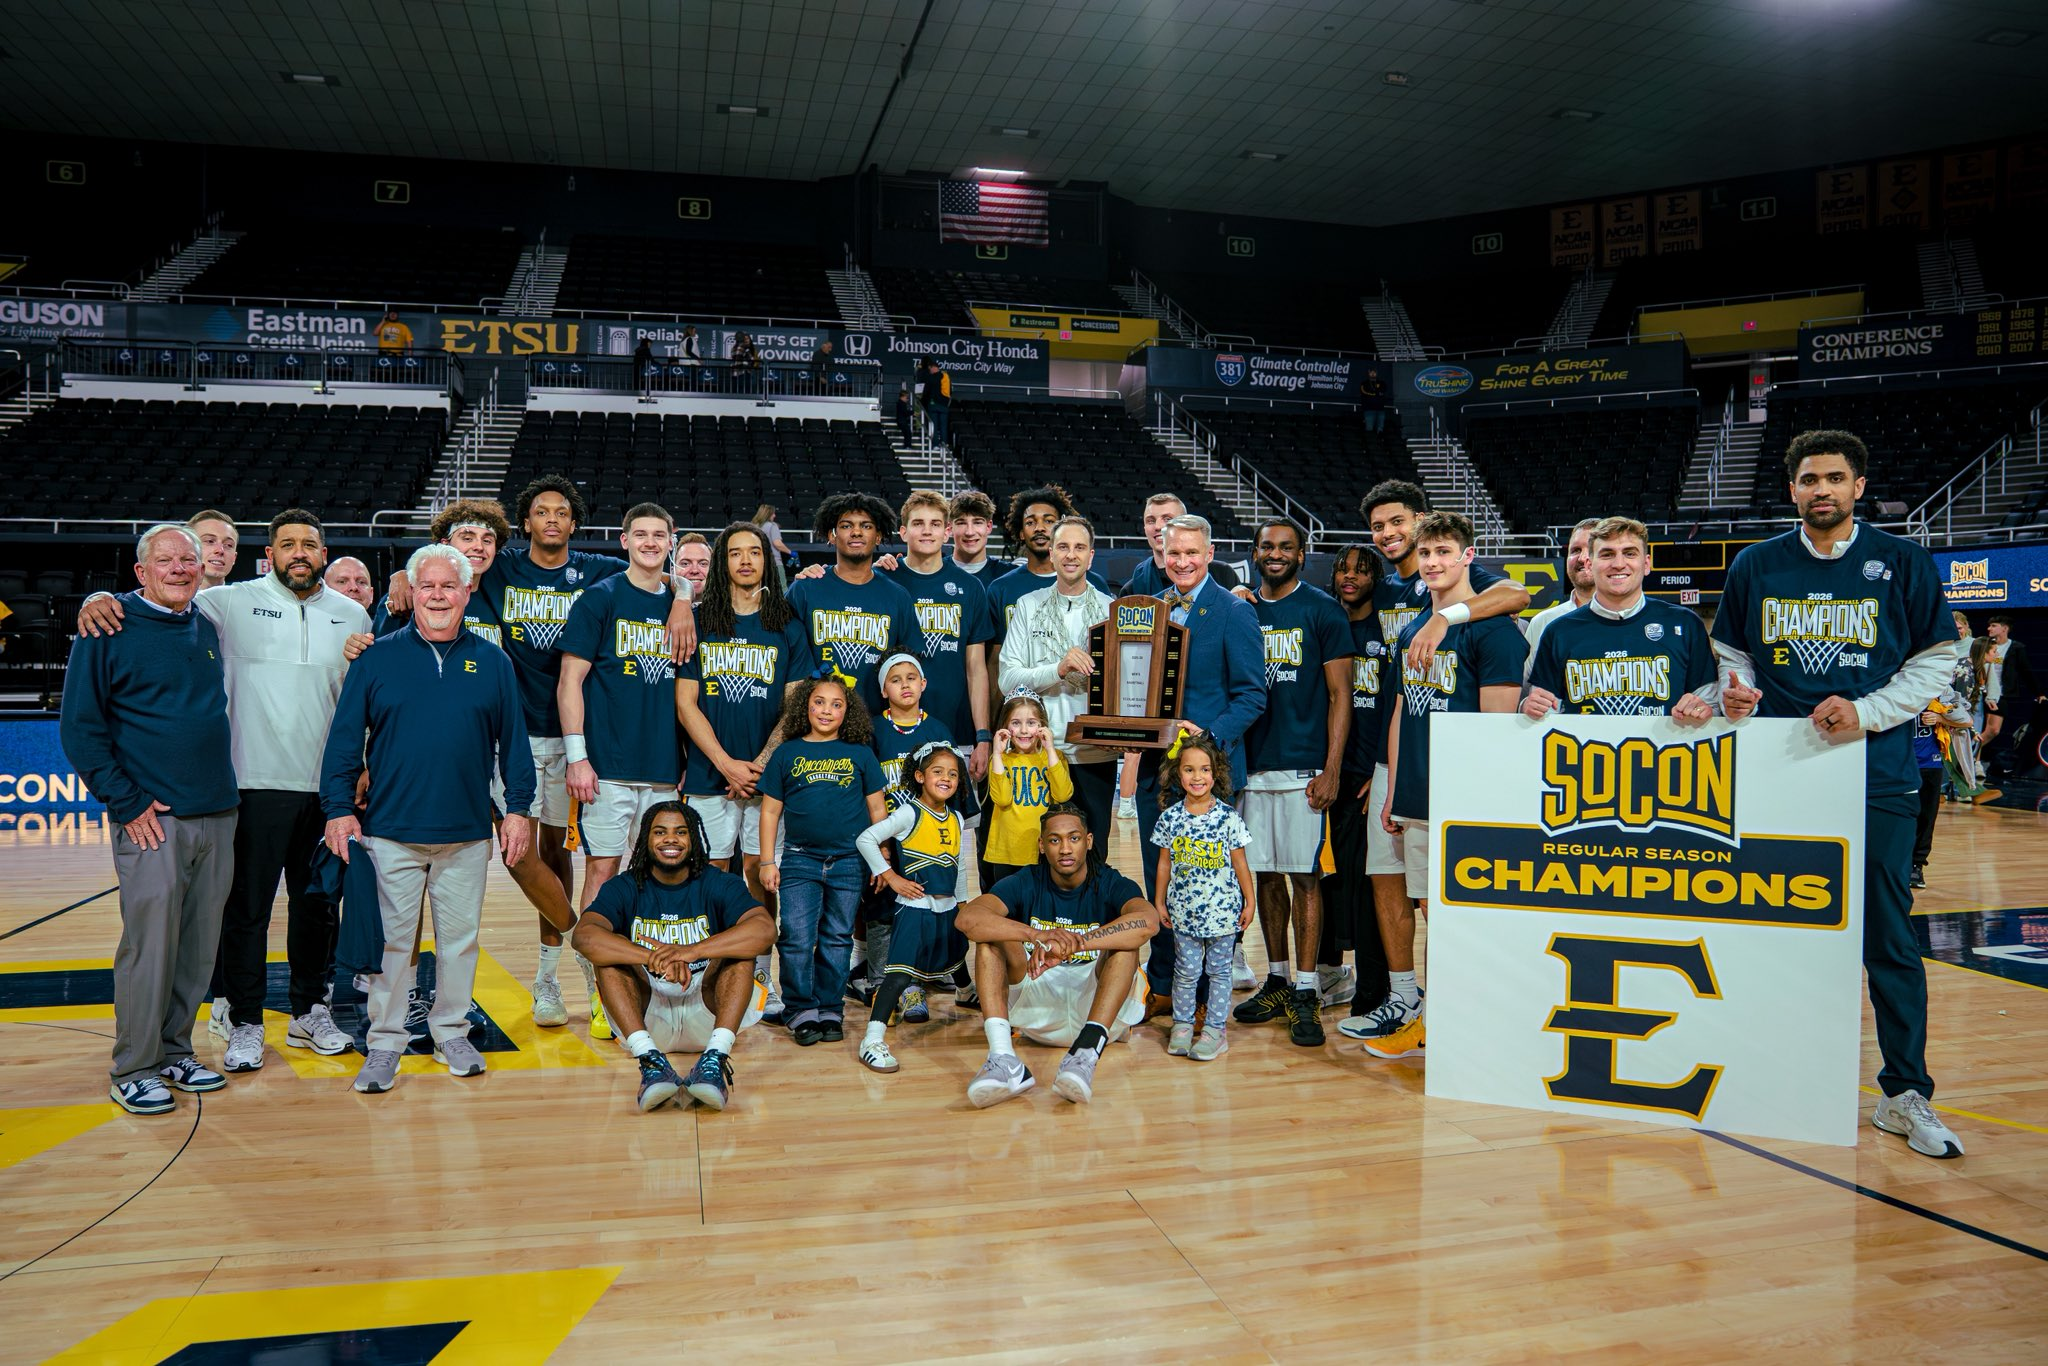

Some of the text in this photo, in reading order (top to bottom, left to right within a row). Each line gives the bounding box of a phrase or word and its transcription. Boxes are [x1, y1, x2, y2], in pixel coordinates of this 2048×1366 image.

[60, 165, 73, 180] 6
[386, 185, 399, 200] 7
[688, 201, 700, 216] 8
[1615, 203, 1634, 223] E
[1667, 195, 1688, 216] E
[1748, 201, 1770, 218] 11
[1562, 210, 1582, 230] E
[1659, 216, 1698, 231] NCAA
[1554, 231, 1591, 245] NCAA
[1606, 224, 1643, 238] NCAA
[1231, 239, 1251, 253] 10
[1477, 237, 1497, 251] 10
[0, 300, 104, 327] GUSON
[1977, 308, 2035, 322] 1968 1978
[247, 309, 367, 335] Eastman
[1020, 318, 1056, 327] Restrooms
[1979, 319, 2035, 333] 1991 1992
[10, 325, 60, 341] Lighting
[440, 320, 579, 355] ETSU
[750, 334, 817, 348] LET'S GET
[1811, 324, 1944, 348] CONFERENCE
[2008, 330, 2035, 342] 2004
[247, 333, 306, 350] Credit
[888, 335, 1039, 360] Johnson City Honda
[1976, 341, 2034, 356] 2010 2017
[757, 349, 815, 362] MOVING!
[1811, 341, 1932, 363] CHAMPIONS
[833, 357, 882, 367] HONDA
[934, 360, 973, 372] ohnson
[973, 361, 990, 374] City
[990, 363, 1015, 376] Way
[1220, 361, 1242, 378] 381
[1249, 355, 1292, 371] Climate
[1294, 358, 1351, 375] Controlled
[1533, 359, 1550, 372] A
[1249, 370, 1306, 392] Storage
[1661, 576, 1691, 585] PERIOD
[1503, 563, 1559, 617] E
[1681, 591, 1698, 602] EXIT
[1944, 588, 2005, 599] HAMPIONS
[253, 607, 282, 619] ETSU
[813, 609, 891, 651] CHAMPIONS
[1762, 597, 1879, 648] CHAMPIONS
[511, 625, 524, 641] E
[1264, 628, 1303, 666] PIONS
[699, 641, 779, 684] CHAMPIONS
[1773, 648, 1790, 665] E
[1839, 652, 1868, 668] SOCON
[464, 660, 477, 673] E
[623, 660, 637, 675] E
[1565, 655, 1670, 703] CHAMPIONS
[706, 681, 719, 696] E
[791, 756, 855, 777] Buccaneers
[1541, 727, 1737, 842] SOCON
[938, 828, 951, 845] E
[1172, 836, 1224, 858] etsu
[1542, 842, 1732, 863] REGULAR SEASON
[1453, 856, 1832, 910] CHAMPIONS
[1055, 917, 1073, 925] 2026
[1541, 931, 1725, 1125] E
